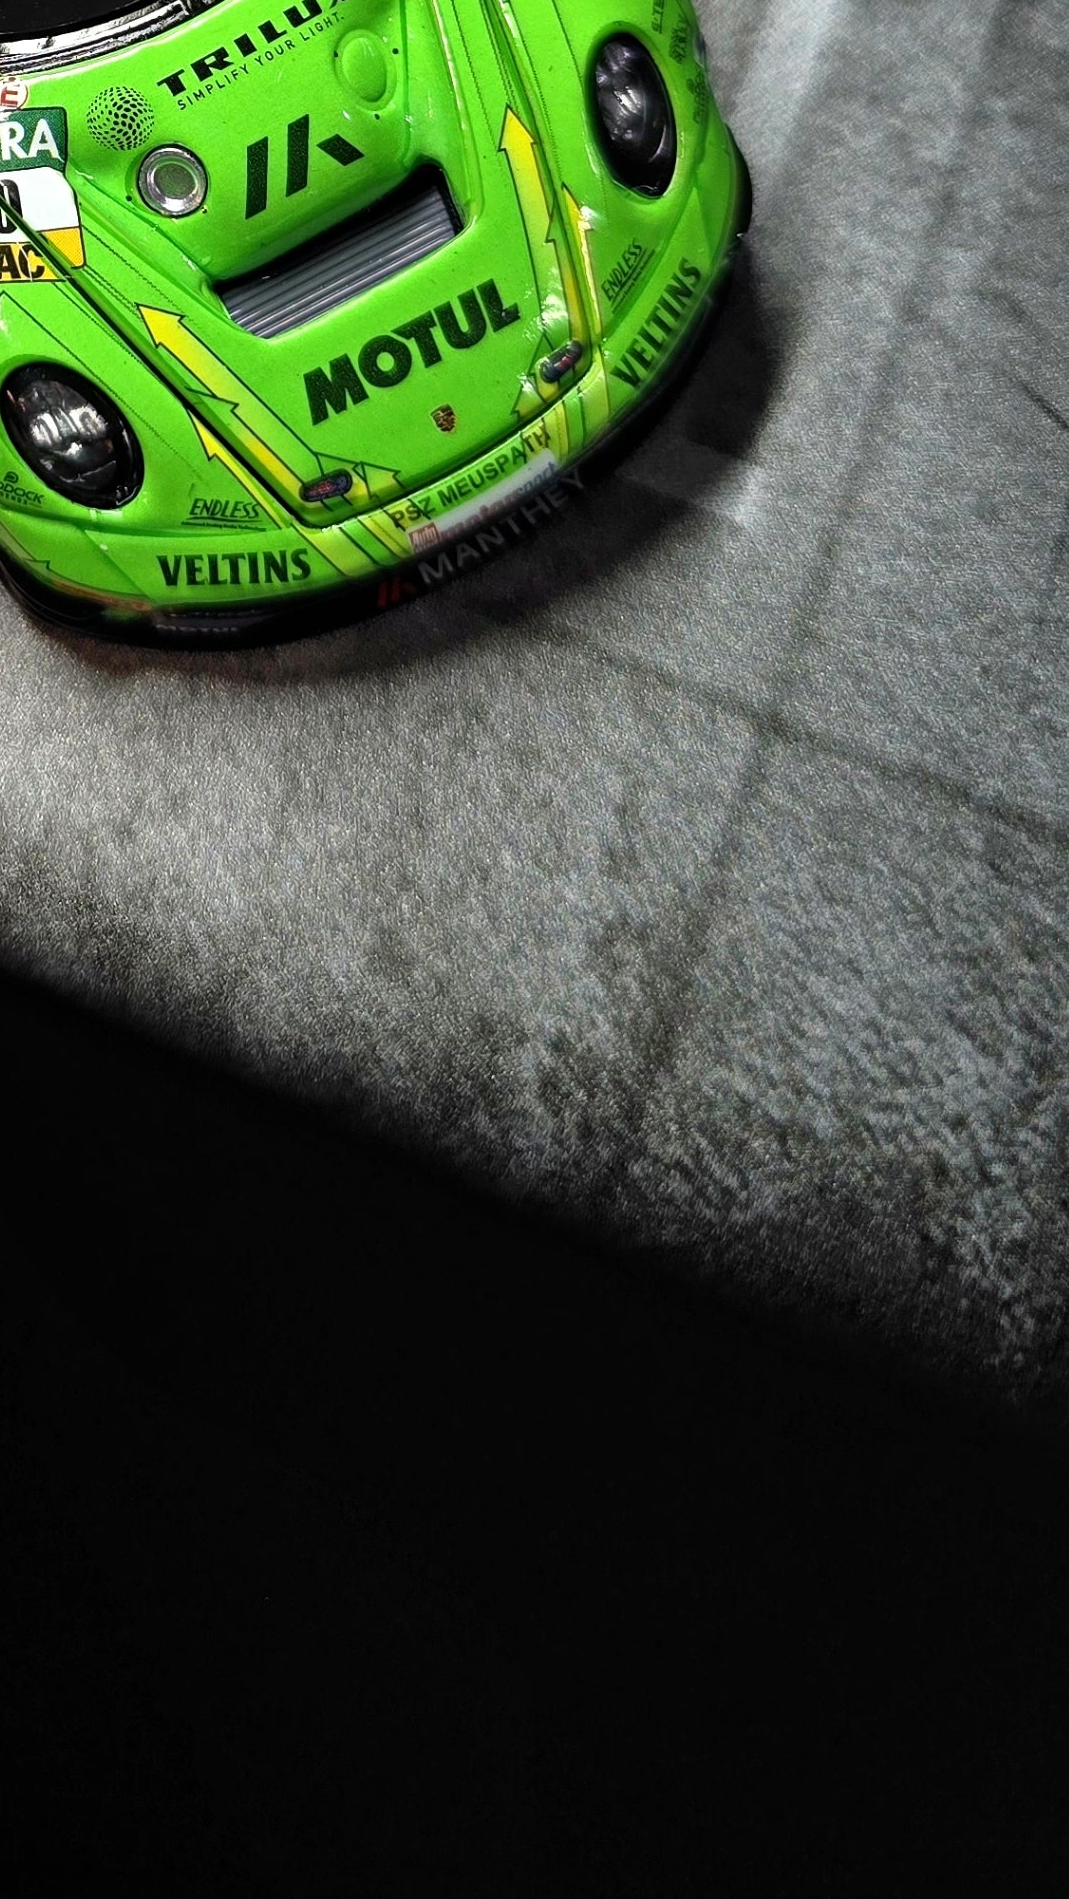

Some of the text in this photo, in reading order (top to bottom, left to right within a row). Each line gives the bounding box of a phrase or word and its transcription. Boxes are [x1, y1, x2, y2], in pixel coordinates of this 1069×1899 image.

[176, 11, 346, 111] SIMPLIFY YOUR LIGHT.
[601, 238, 643, 303] ENDLESS
[303, 278, 522, 426] MOTUL
[610, 257, 702, 389] VELTINS
[189, 497, 260, 519] ENDLESS
[391, 495, 436, 529] PSZ
[418, 466, 585, 585] MANTHEY
[156, 548, 312, 587] VELTINS
